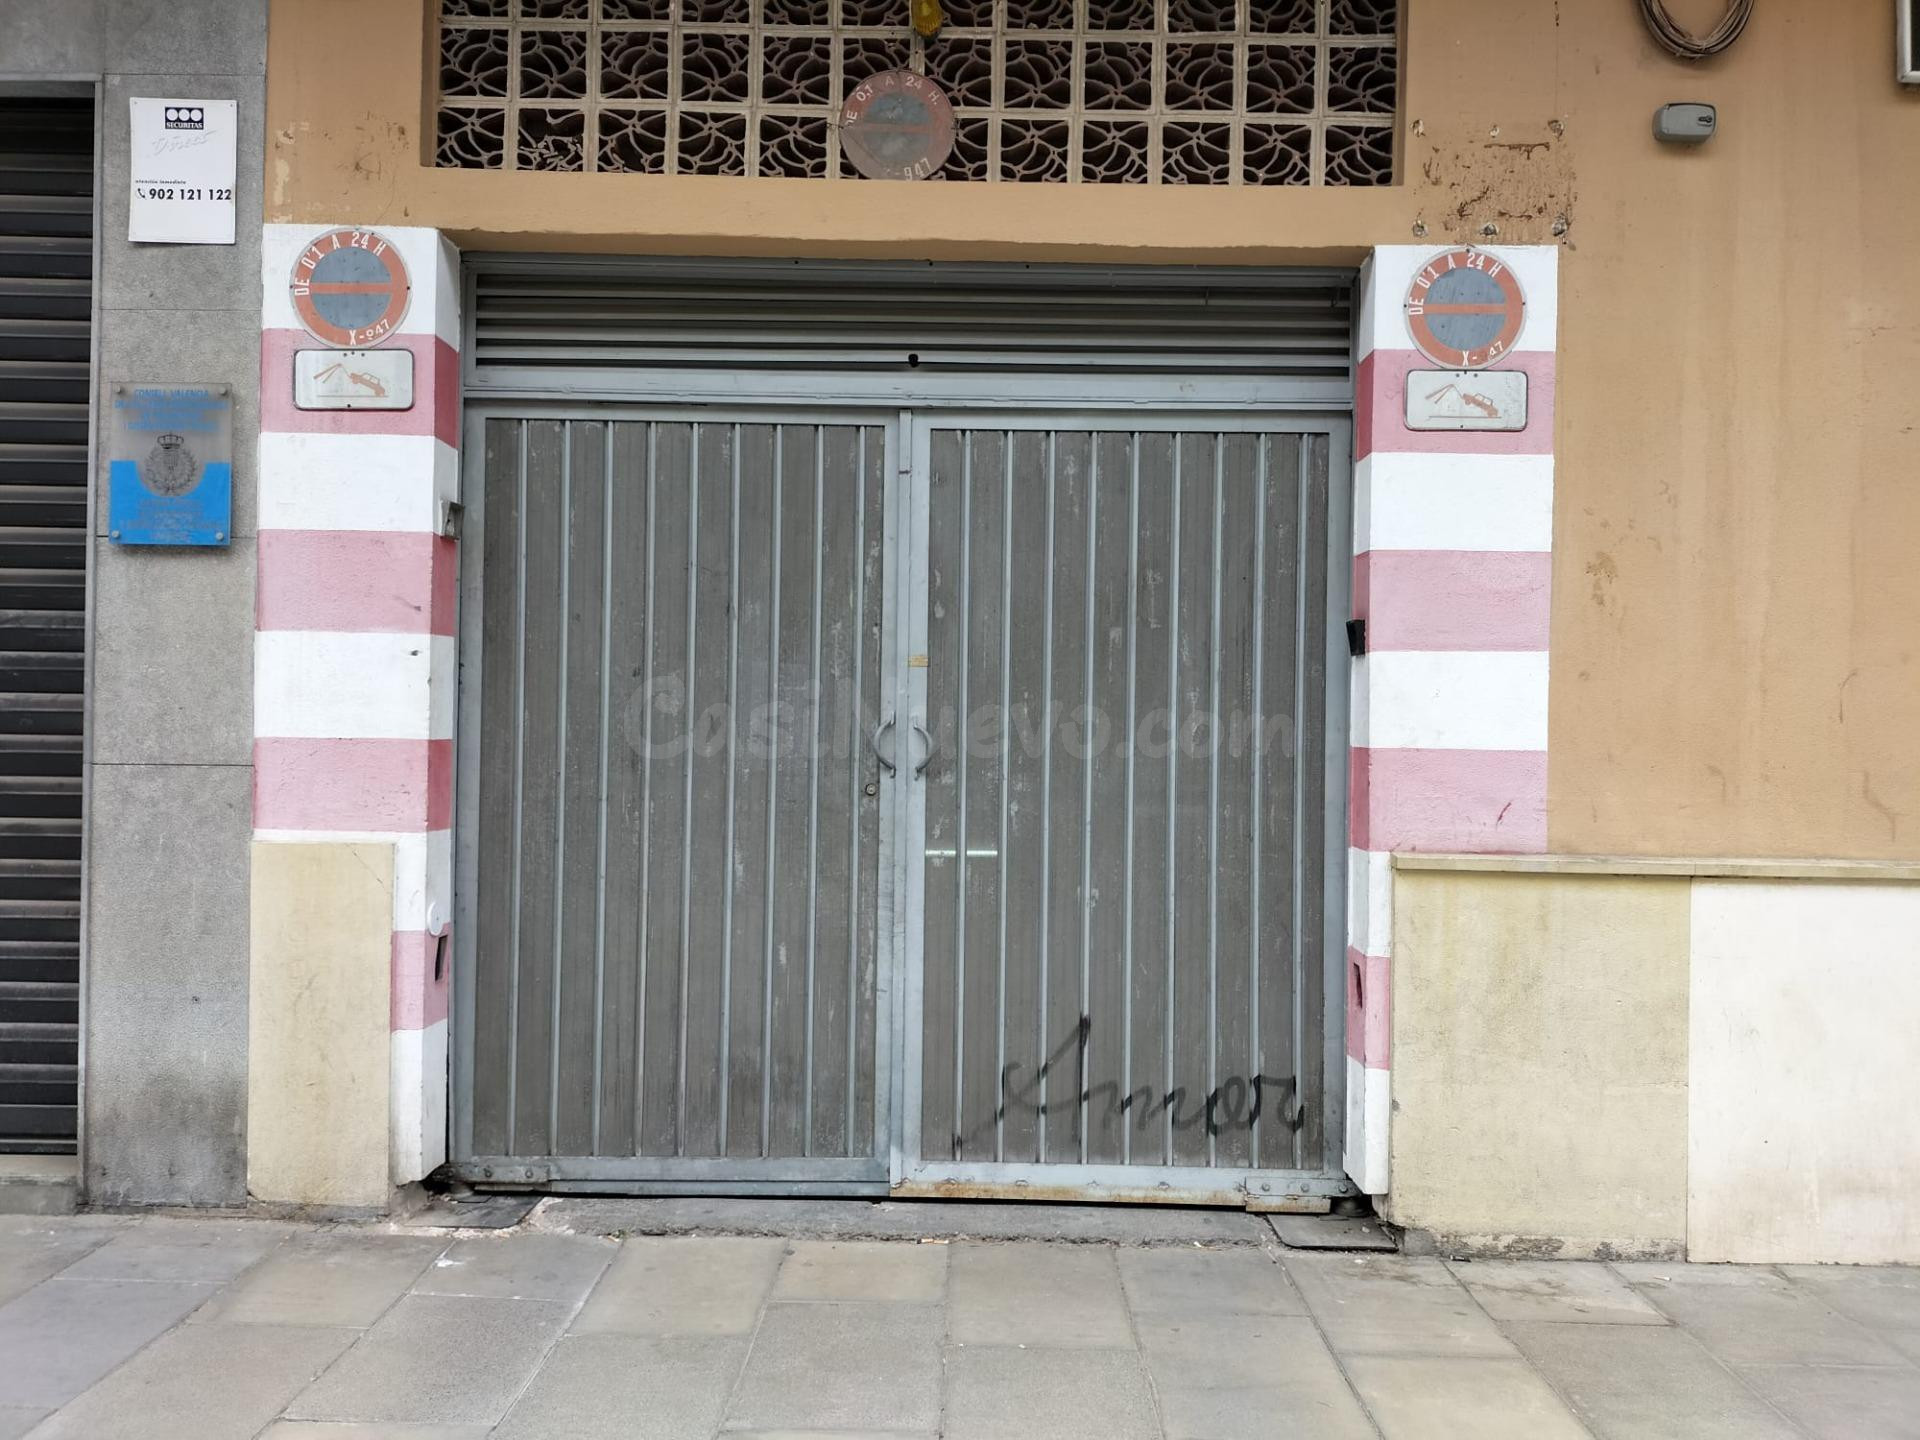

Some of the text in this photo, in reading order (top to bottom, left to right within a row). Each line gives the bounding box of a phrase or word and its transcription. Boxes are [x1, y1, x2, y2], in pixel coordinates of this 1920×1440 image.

[885, 76, 894, 86] A
[906, 76, 923, 89] 24
[166, 121, 203, 129] SECURITAS
[149, 188, 232, 200] 902 121 122
[294, 278, 310, 296] DE
[331, 234, 341, 250] A
[351, 231, 369, 249] 24
[373, 240, 387, 257] H
[1409, 296, 1425, 315] DE
[1447, 254, 1457, 269] A
[1467, 252, 1485, 270] 24
[1487, 261, 1502, 277] H
